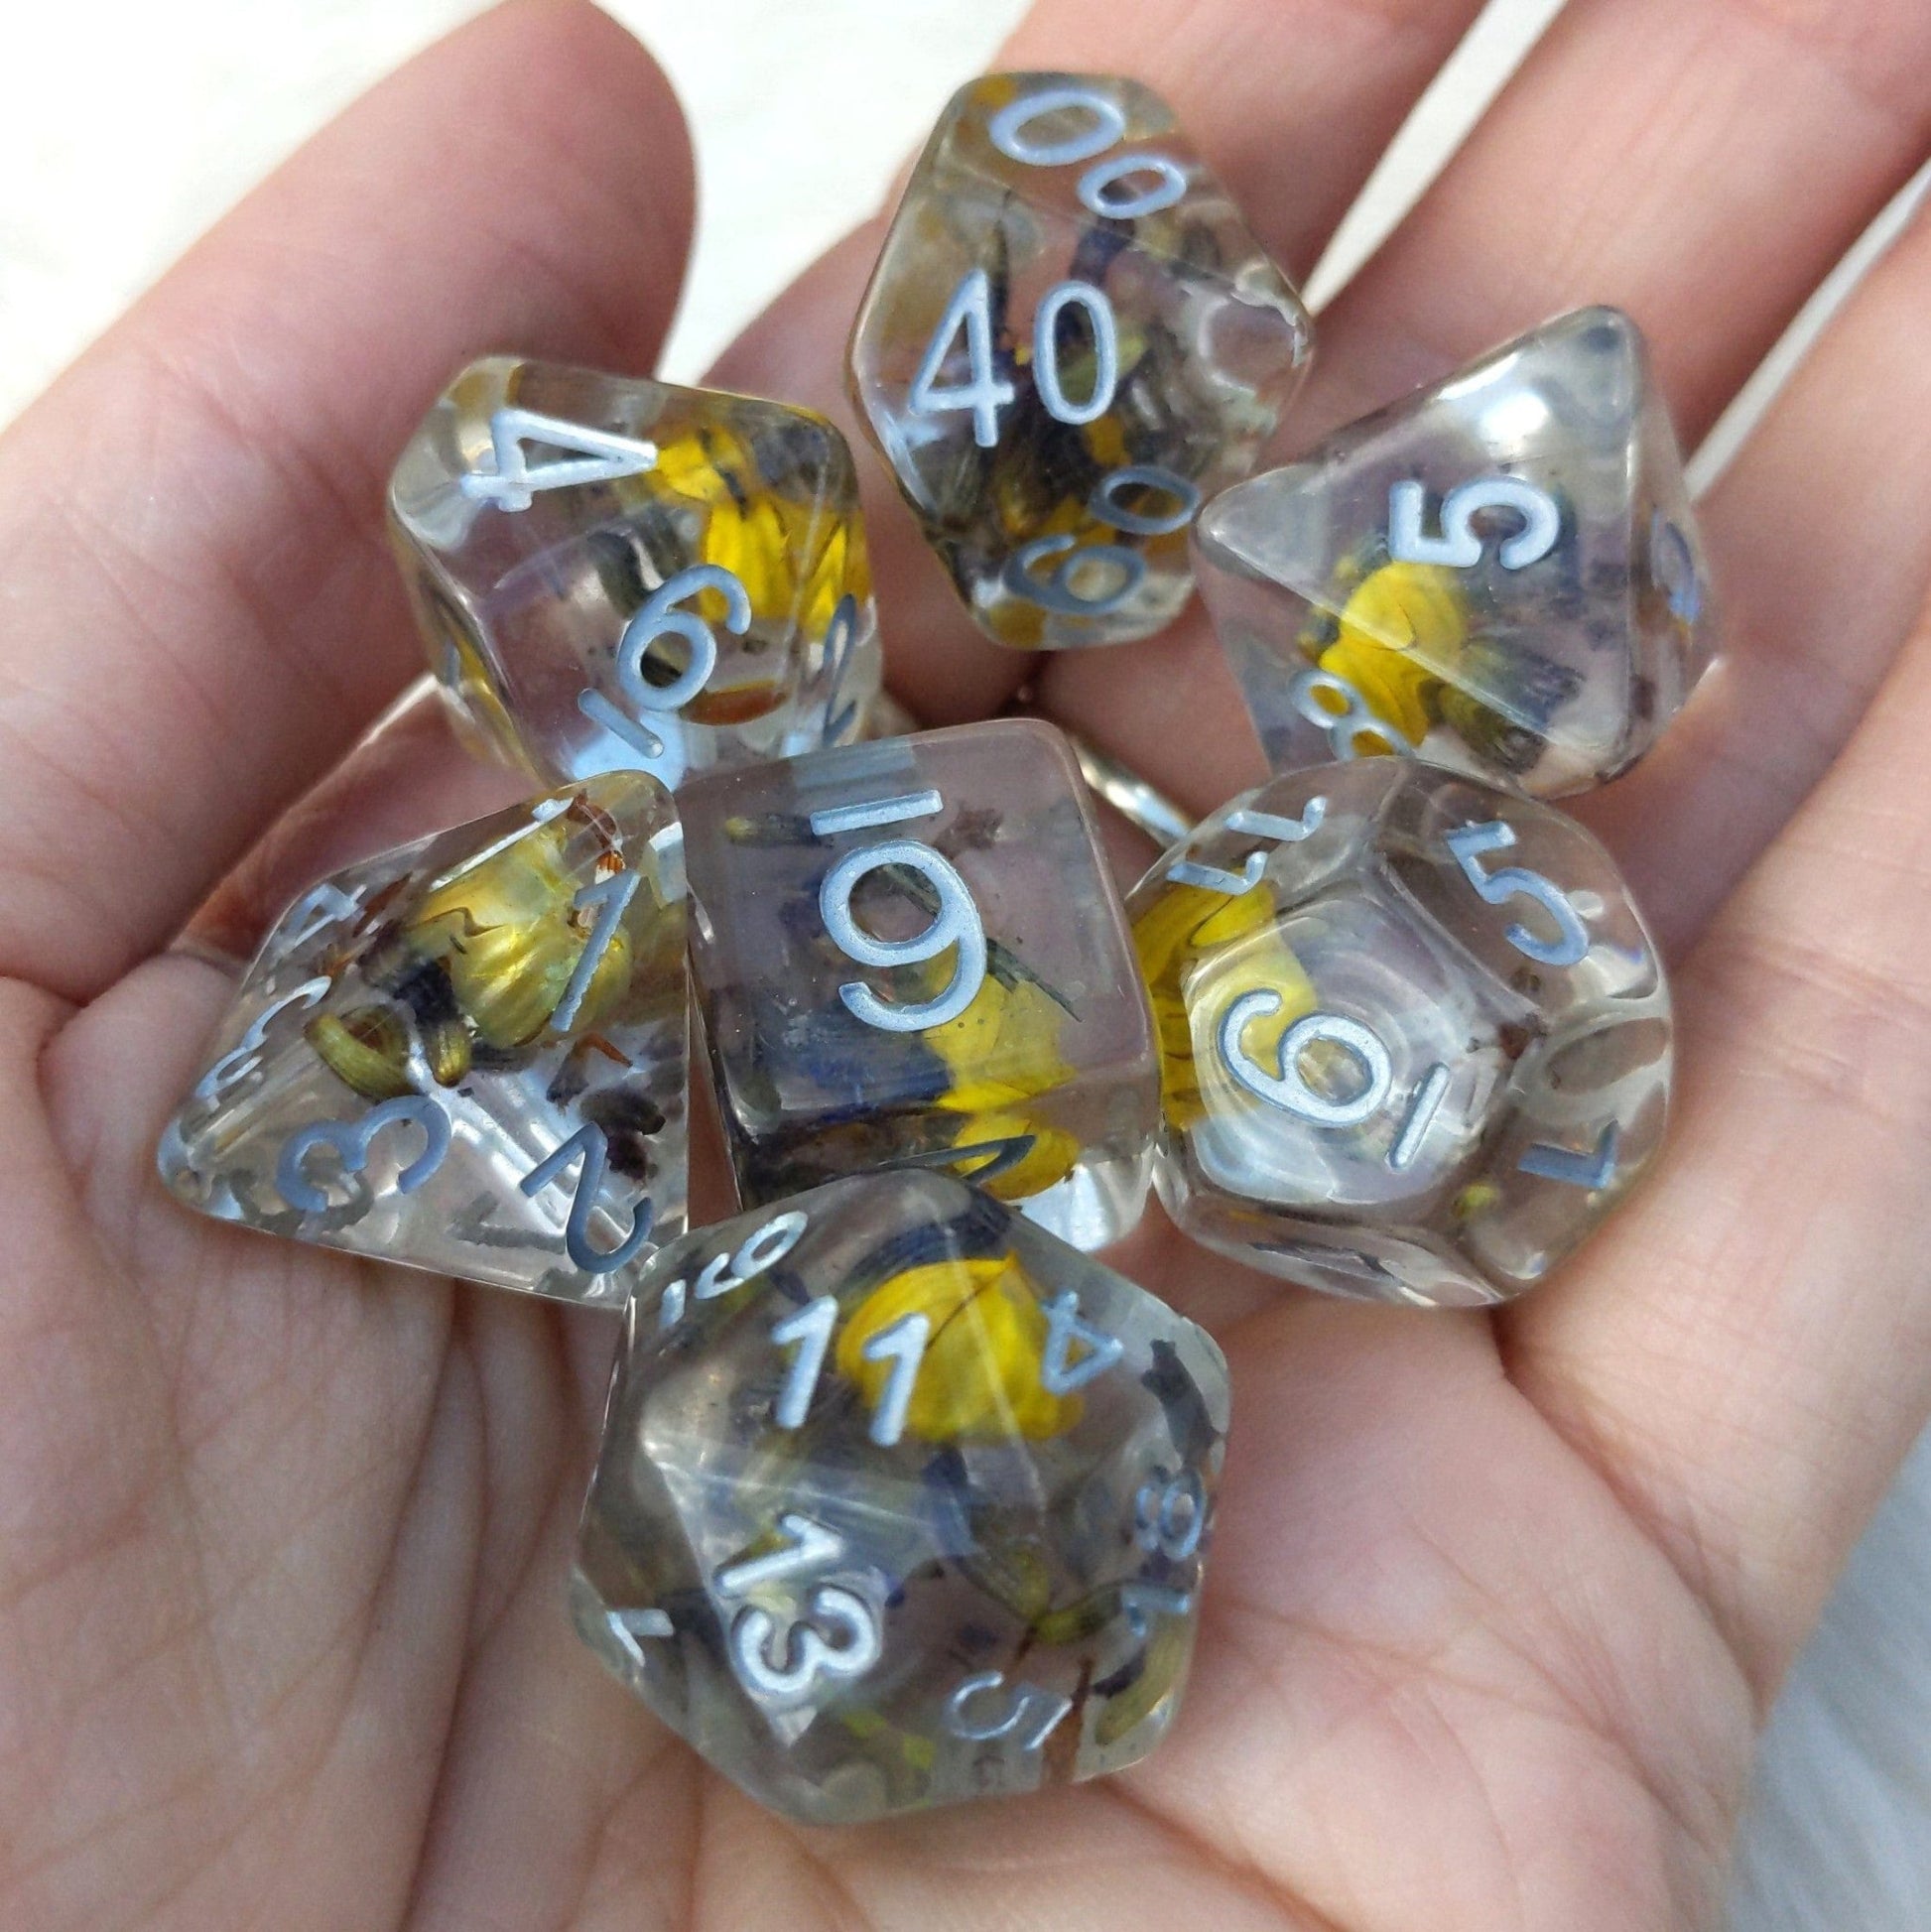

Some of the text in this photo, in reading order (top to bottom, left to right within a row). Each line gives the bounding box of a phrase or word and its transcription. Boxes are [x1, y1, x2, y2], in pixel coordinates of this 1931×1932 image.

[991, 87, 1188, 220] 00
[909, 268, 1116, 449] 40
[459, 410, 660, 512] 4
[1391, 474, 1561, 571] 5
[1447, 819, 1590, 966] 5
[275, 1094, 452, 1213] 3
[520, 1121, 653, 1273] 2
[771, 1295, 931, 1446] 11
[1038, 1291, 1123, 1397] 4
[713, 1513, 884, 1695] 13
